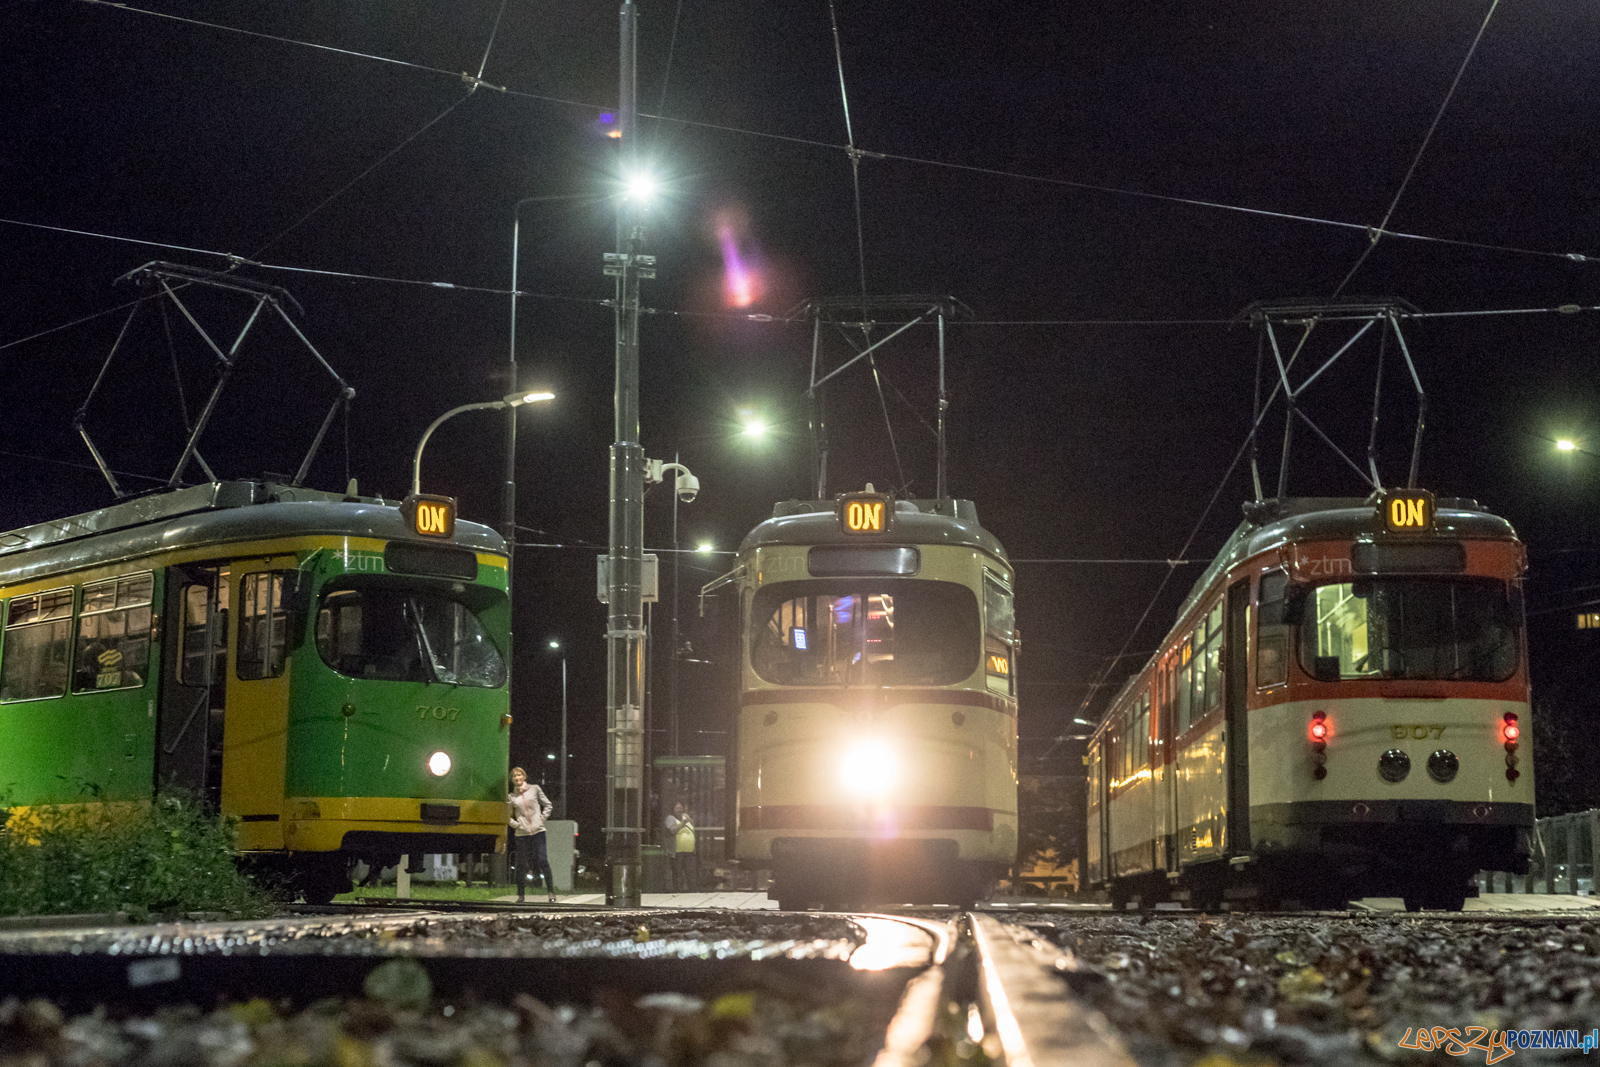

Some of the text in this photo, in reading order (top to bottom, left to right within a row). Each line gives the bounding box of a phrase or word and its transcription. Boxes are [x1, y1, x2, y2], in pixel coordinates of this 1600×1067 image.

[418, 505, 446, 533] ON
[849, 503, 882, 530] ON
[1391, 499, 1425, 526] ON
[1310, 555, 1352, 576] ztm
[97, 671, 121, 688] 707
[415, 704, 461, 722] 707
